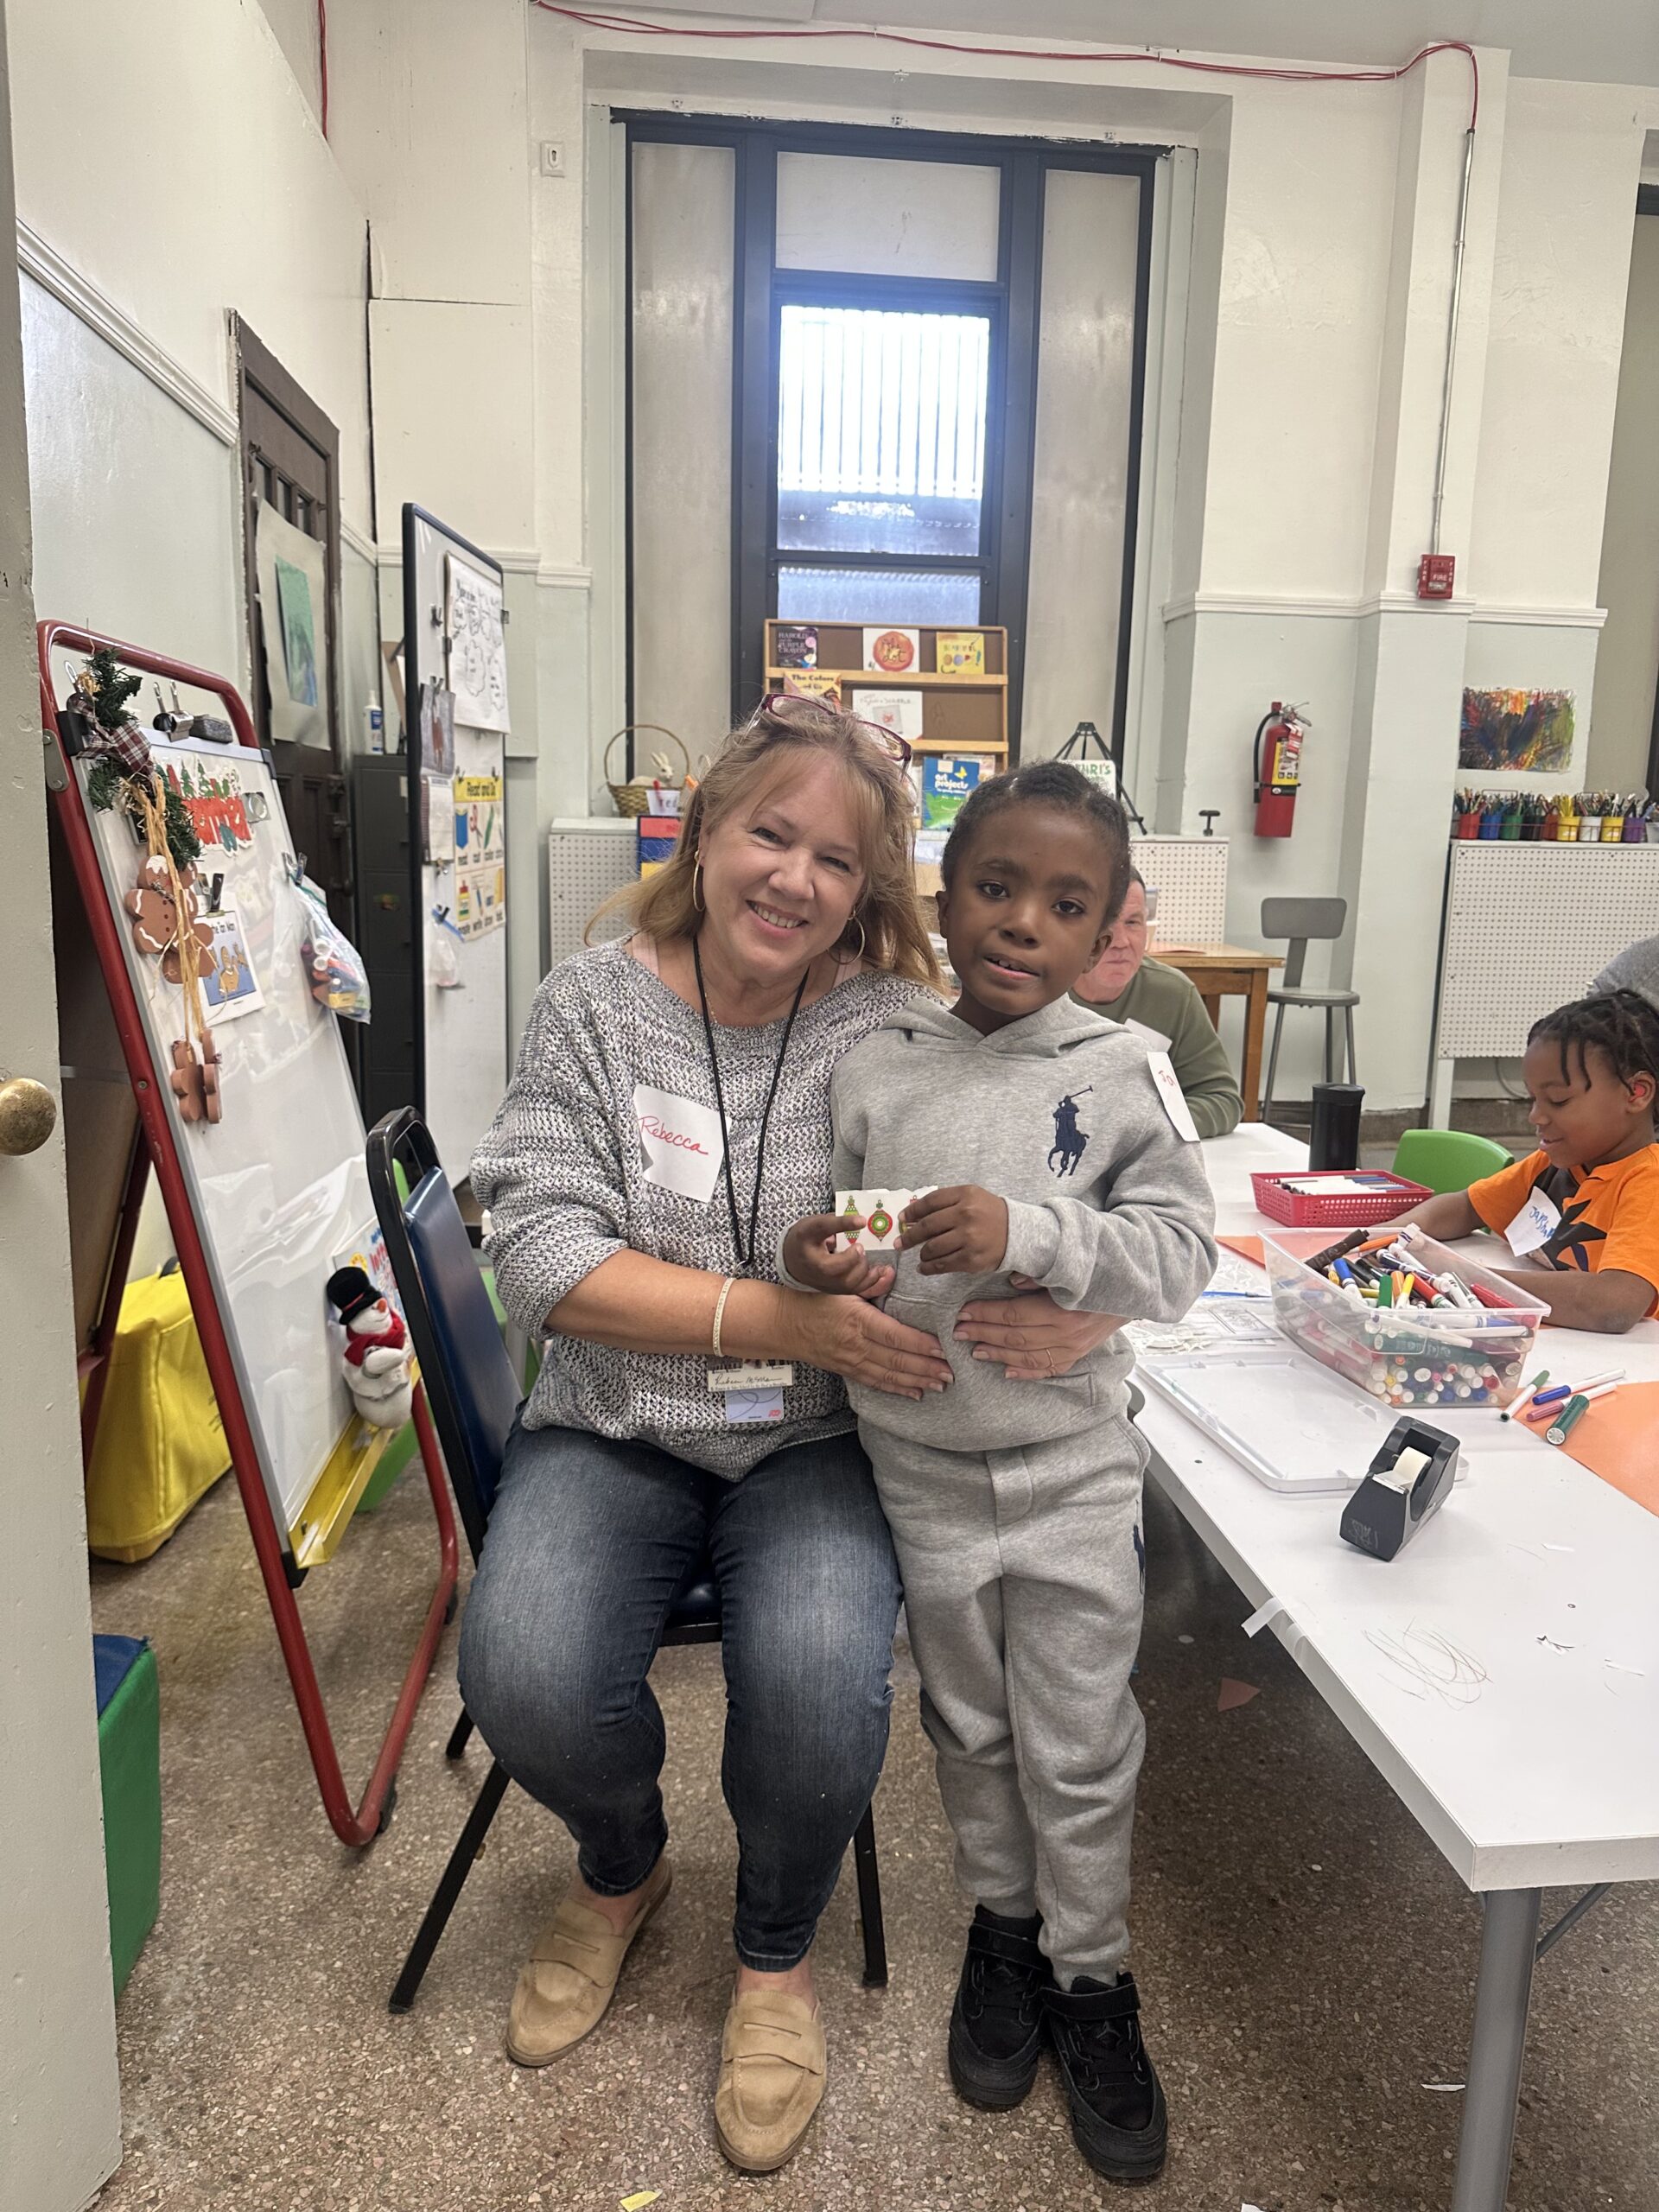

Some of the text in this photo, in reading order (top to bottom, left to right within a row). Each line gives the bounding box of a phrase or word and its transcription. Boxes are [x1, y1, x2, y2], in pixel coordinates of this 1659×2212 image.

[882, 646, 906, 663] dot
[467, 781, 480, 797] Read
[934, 779, 969, 790] projects
[639, 1116, 709, 1156] Rebecca
